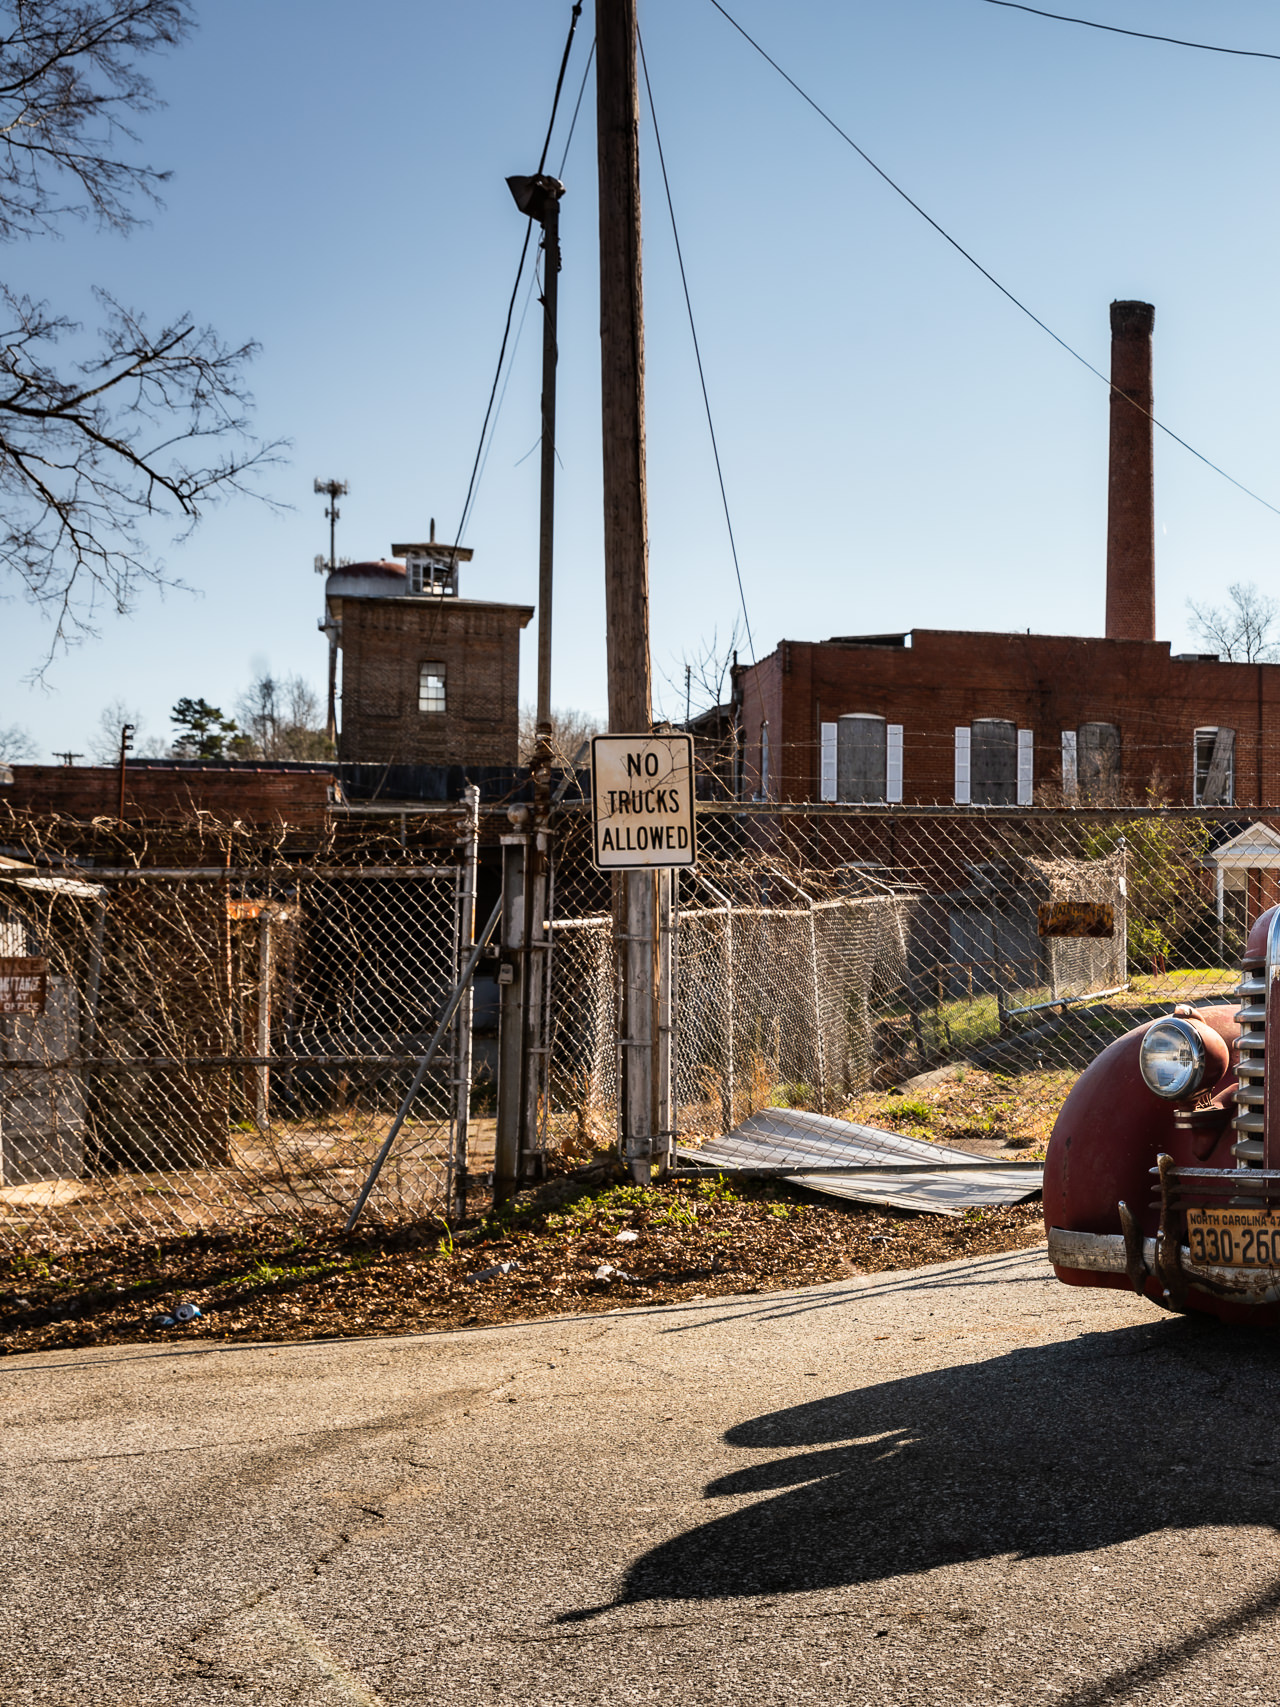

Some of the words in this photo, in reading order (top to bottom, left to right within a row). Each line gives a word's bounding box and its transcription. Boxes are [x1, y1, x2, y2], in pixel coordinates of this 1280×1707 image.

[627, 752, 659, 777] NO
[607, 789, 680, 814] TRUCKS
[602, 826, 688, 851] ALLOWED
[4, 1002, 40, 1010] OFFICE
[16, 993, 29, 1001] AT
[1190, 1213, 1220, 1226] NORTH
[1222, 1214, 1267, 1227] CAROLINA
